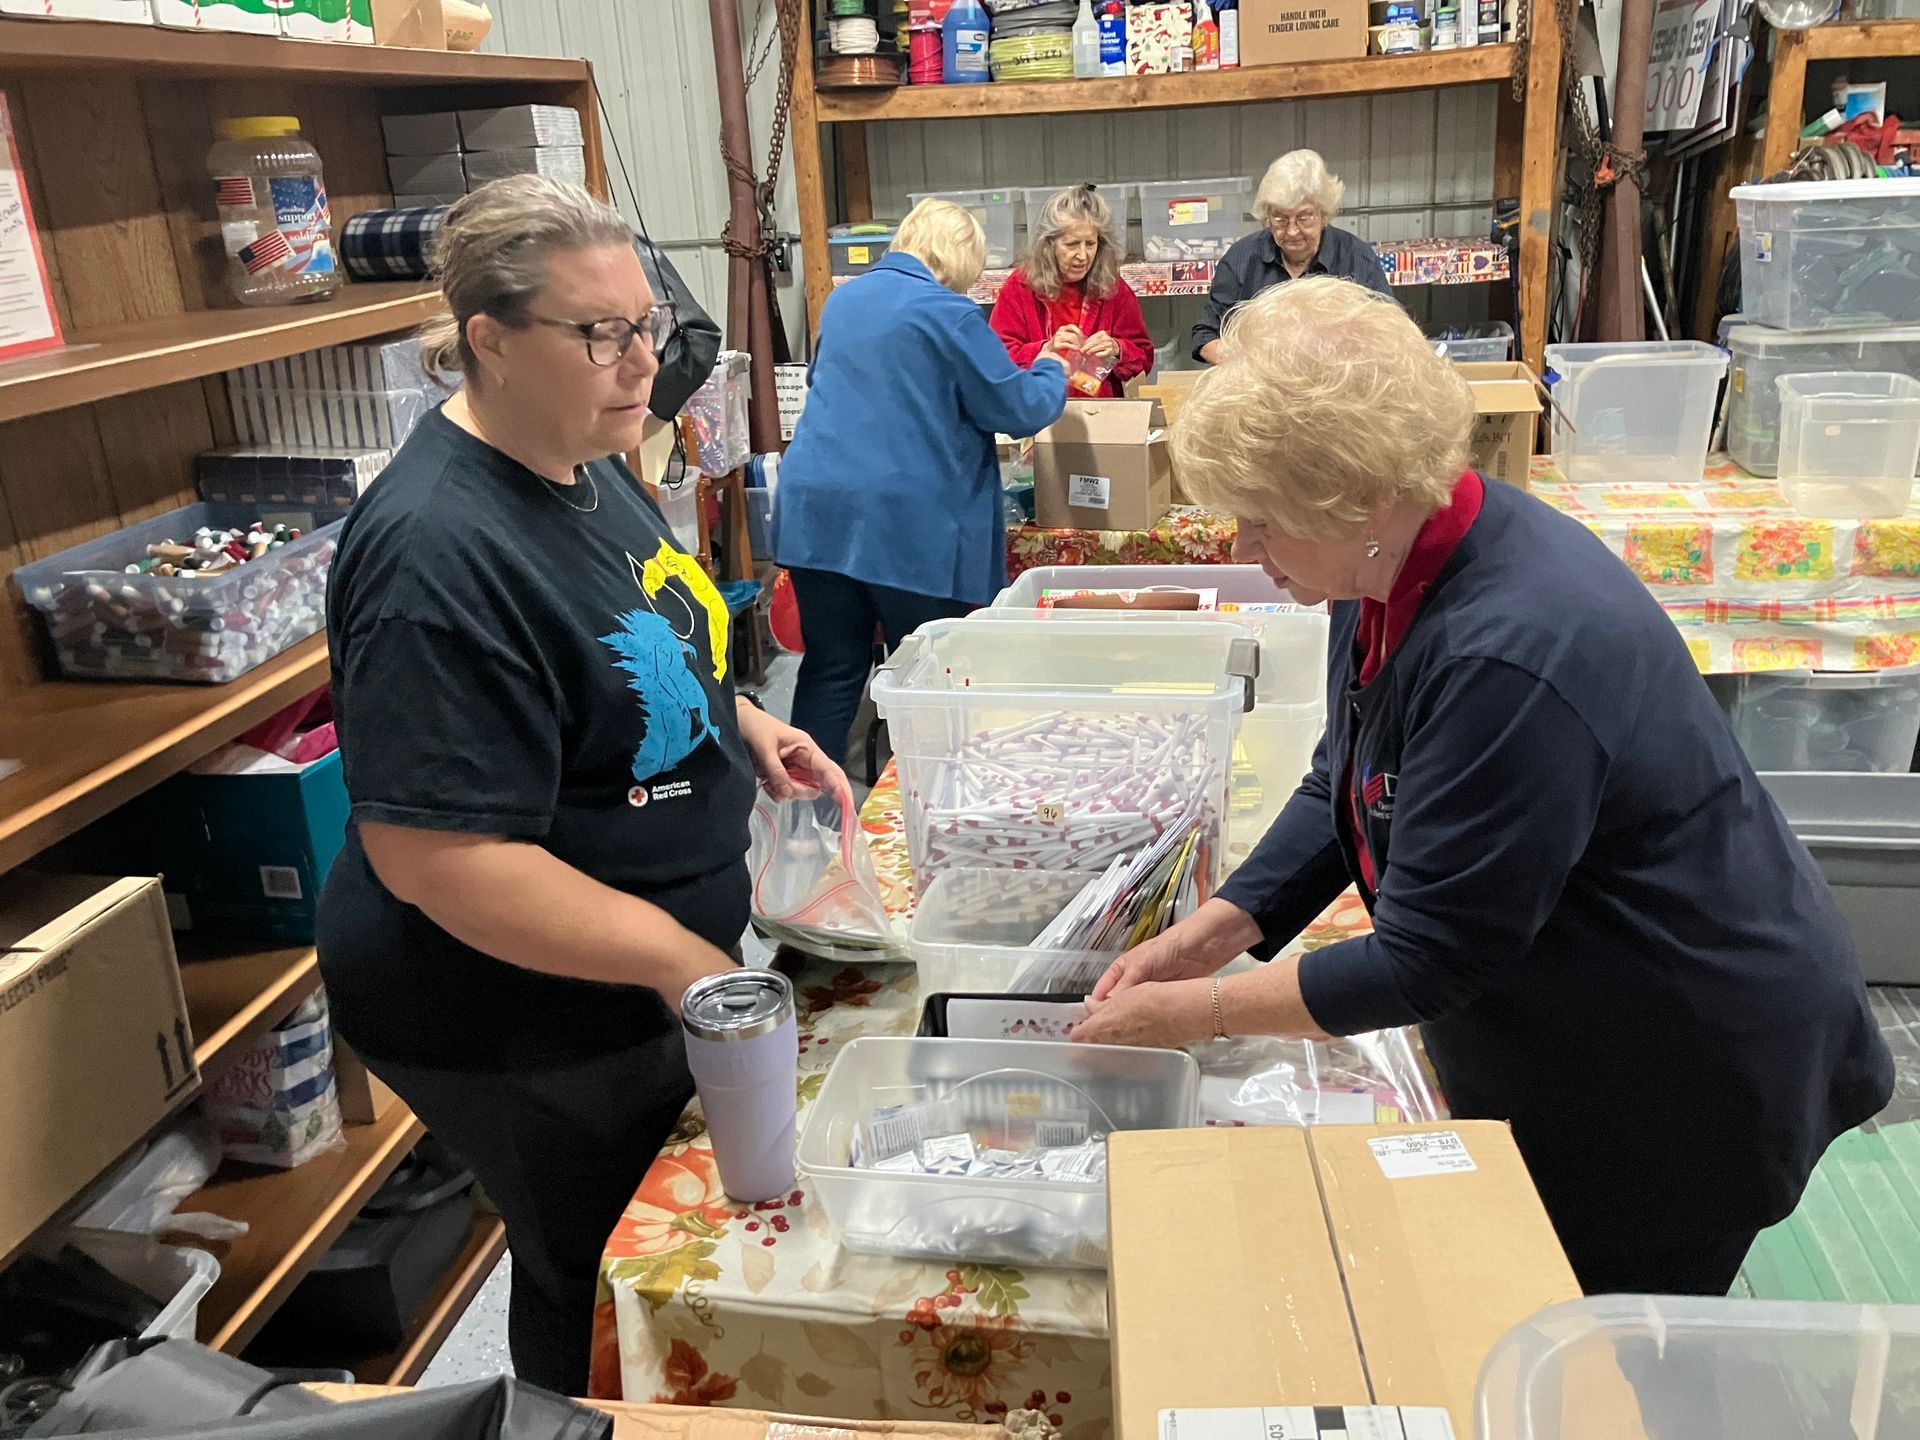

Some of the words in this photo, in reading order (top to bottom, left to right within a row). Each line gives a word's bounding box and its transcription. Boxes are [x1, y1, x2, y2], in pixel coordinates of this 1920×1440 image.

[1280, 11, 1307, 21] HANDLE
[1309, 9, 1327, 18] WITH
[1268, 22, 1294, 33] TENDER
[1295, 20, 1320, 31] LOVING
[1322, 18, 1340, 28] CARE
[778, 407, 803, 415] roops!
[652, 781, 690, 793] American
[653, 790, 669, 800] Red
[669, 787, 692, 797] Cross
